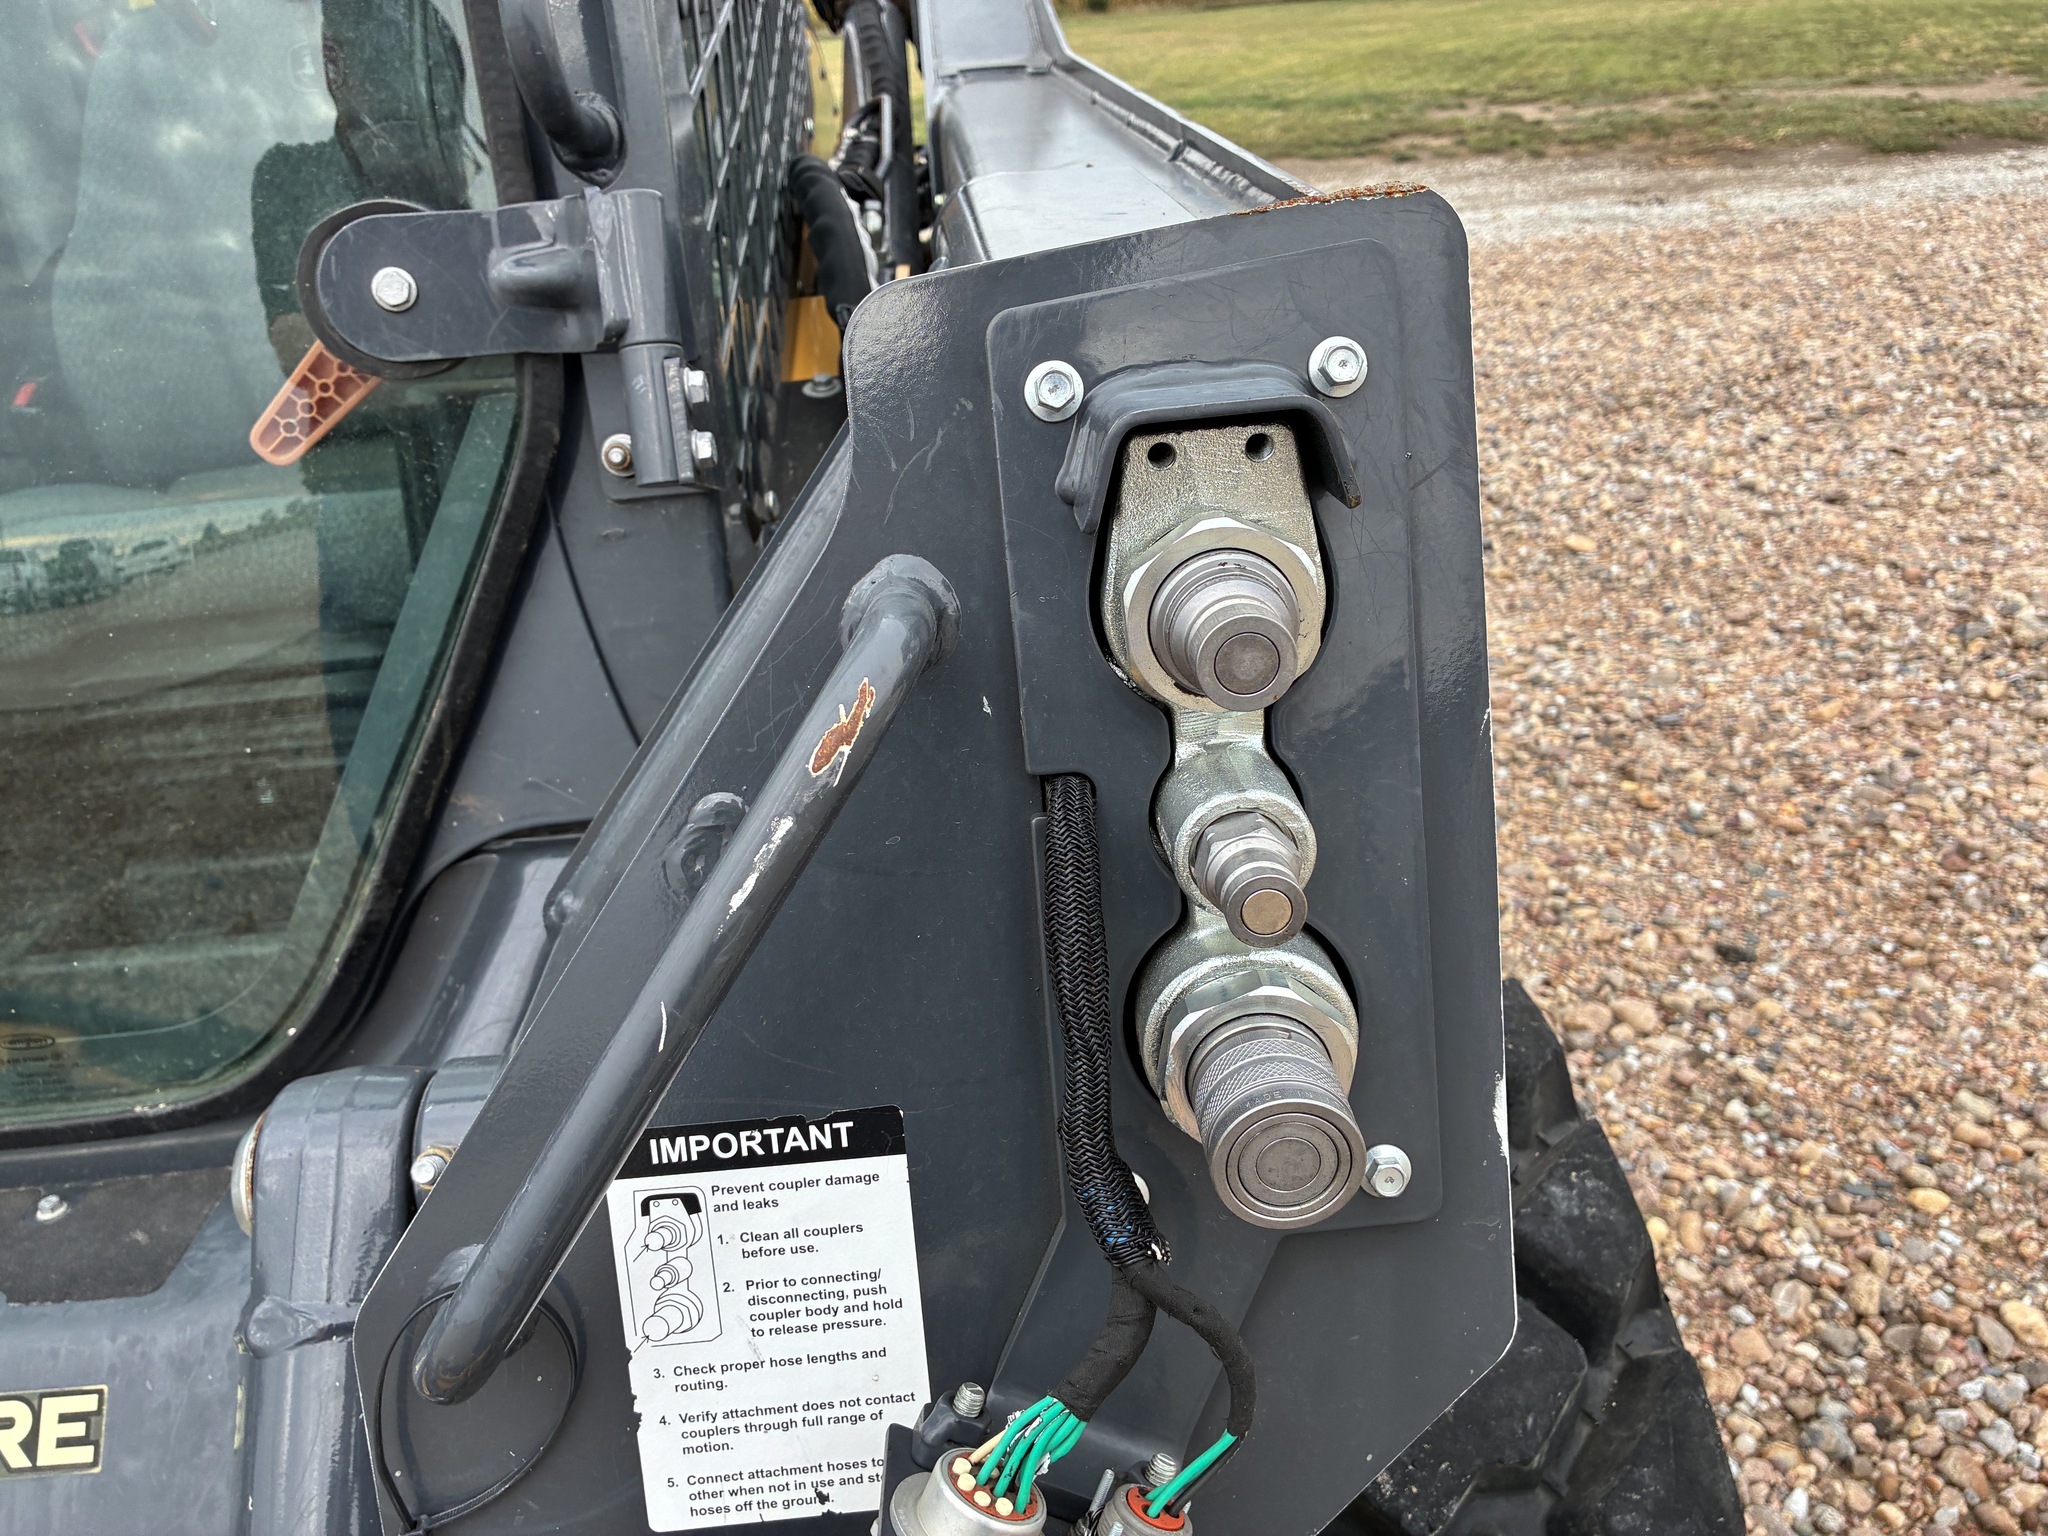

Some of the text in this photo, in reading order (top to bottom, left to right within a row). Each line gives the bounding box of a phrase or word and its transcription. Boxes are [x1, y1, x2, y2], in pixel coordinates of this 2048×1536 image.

[649, 1121, 854, 1165] IMPORTANT
[711, 1173, 880, 1197] Prevent coupler damage
[713, 1197, 779, 1213] and leaks
[717, 1223, 864, 1245] 1. Clean all couplers
[741, 1244, 819, 1259] before use.
[722, 1268, 881, 1293] 2. Prior to connecting/
[747, 1283, 887, 1307] disconnecting, push
[749, 1297, 903, 1323] coupler body and hold
[750, 1318, 887, 1338] to release pressure.
[653, 1346, 887, 1379] 3. Check proper hose lengths and
[675, 1380, 728, 1393] routing.
[659, 1391, 916, 1426] 4. Verify attachment does not contact
[681, 1409, 883, 1440] couplers through full range of
[682, 1442, 734, 1455] motion.
[667, 1457, 885, 1488] 5. Connect attachment hoses to
[689, 1489, 724, 1502] other
[728, 1485, 764, 1499] when
[768, 1483, 791, 1494] not
[794, 1480, 806, 1491] in
[811, 1478, 835, 1490] use
[839, 1473, 864, 1486] and
[689, 1493, 835, 1517] hoses off the grou.
